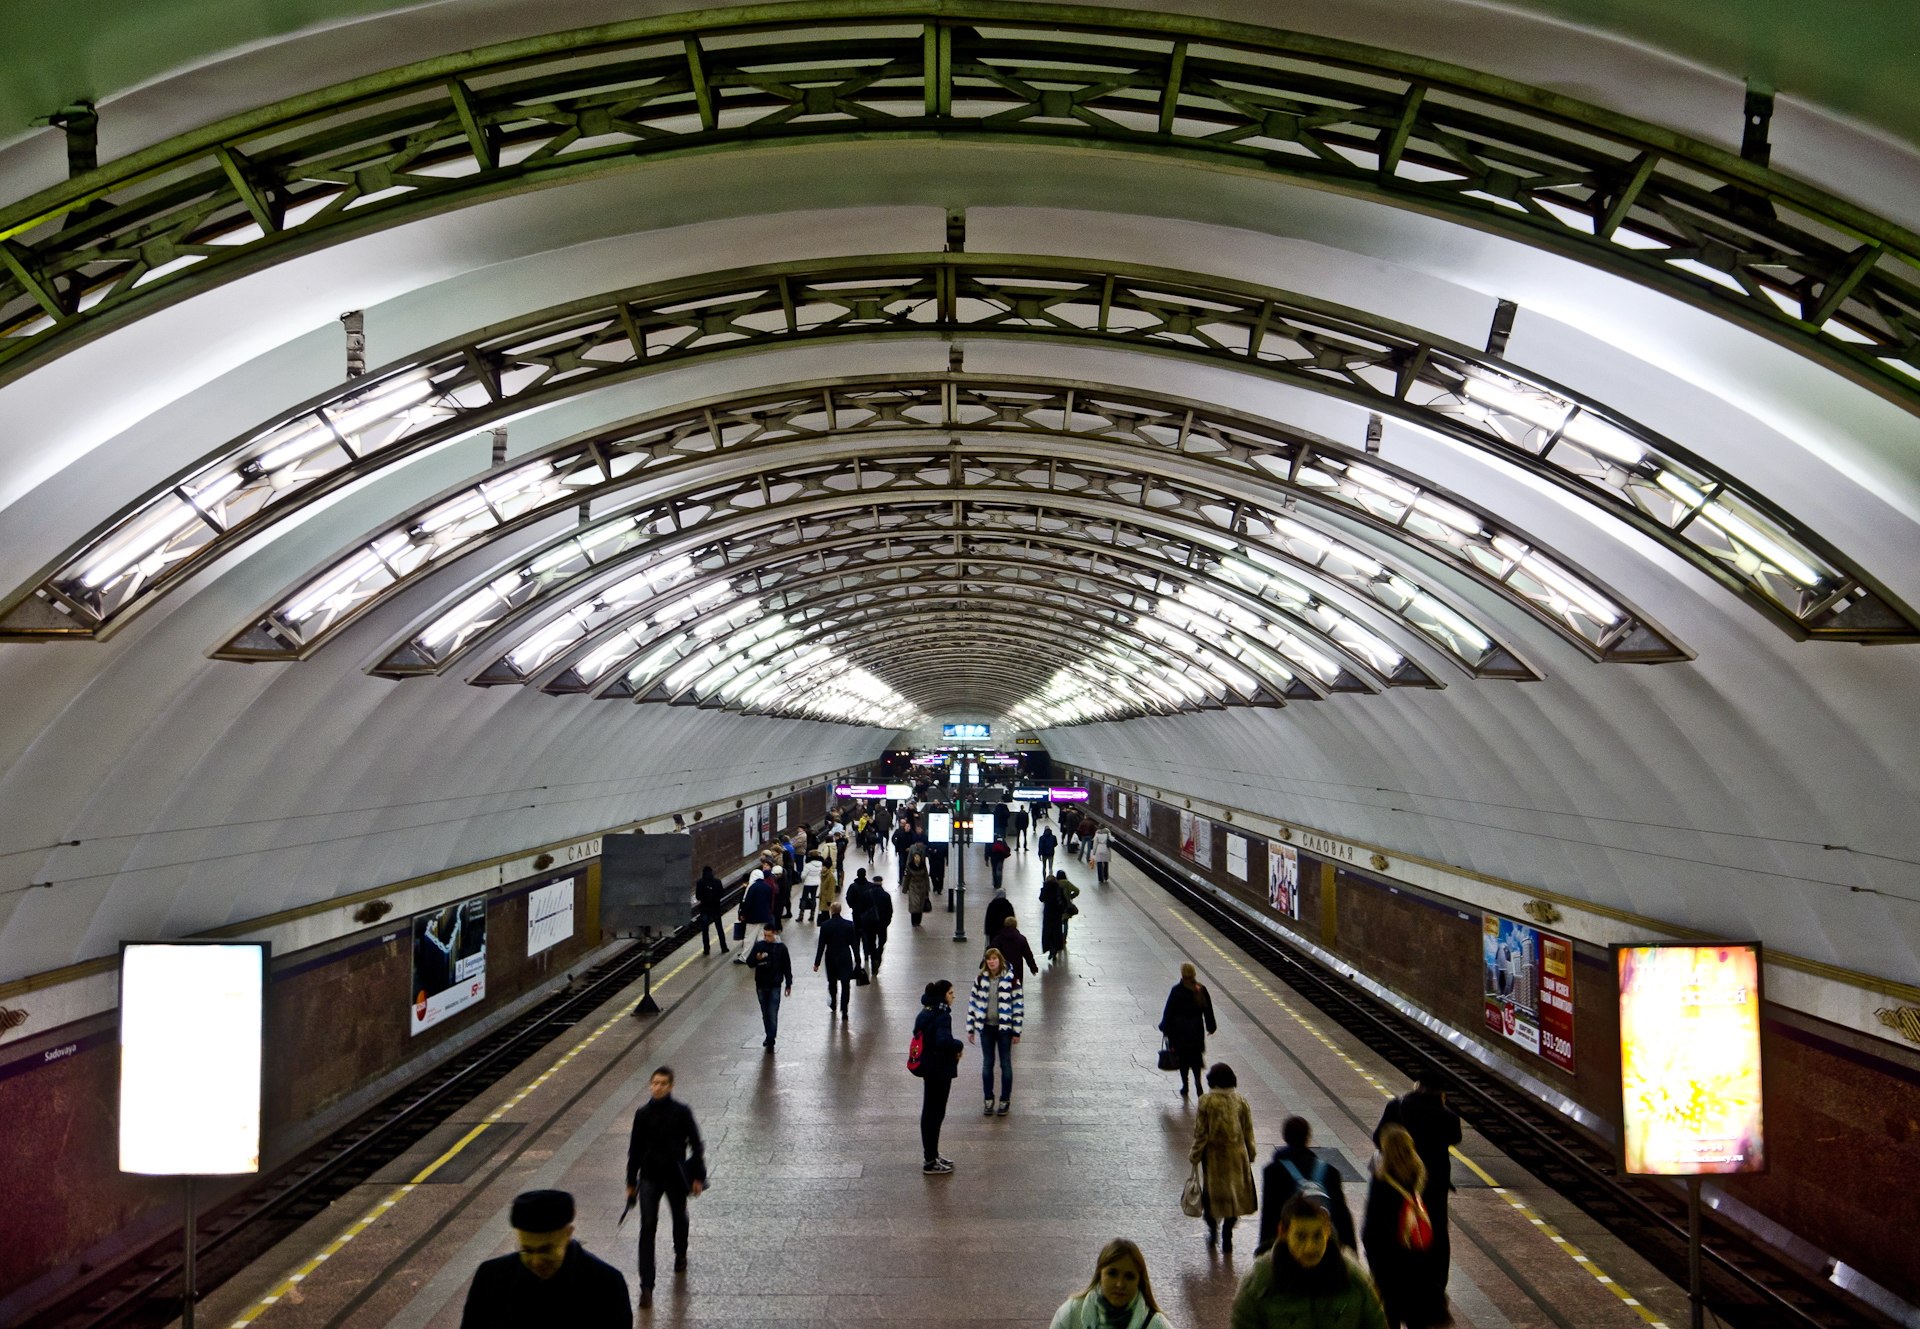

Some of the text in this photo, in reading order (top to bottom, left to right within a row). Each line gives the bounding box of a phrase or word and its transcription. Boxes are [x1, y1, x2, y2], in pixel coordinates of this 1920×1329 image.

[1302, 833, 1354, 861] САДОВАЯ
[44, 1043, 77, 1062] Sadovaya
[1542, 1029, 1572, 1059] 331-2000
